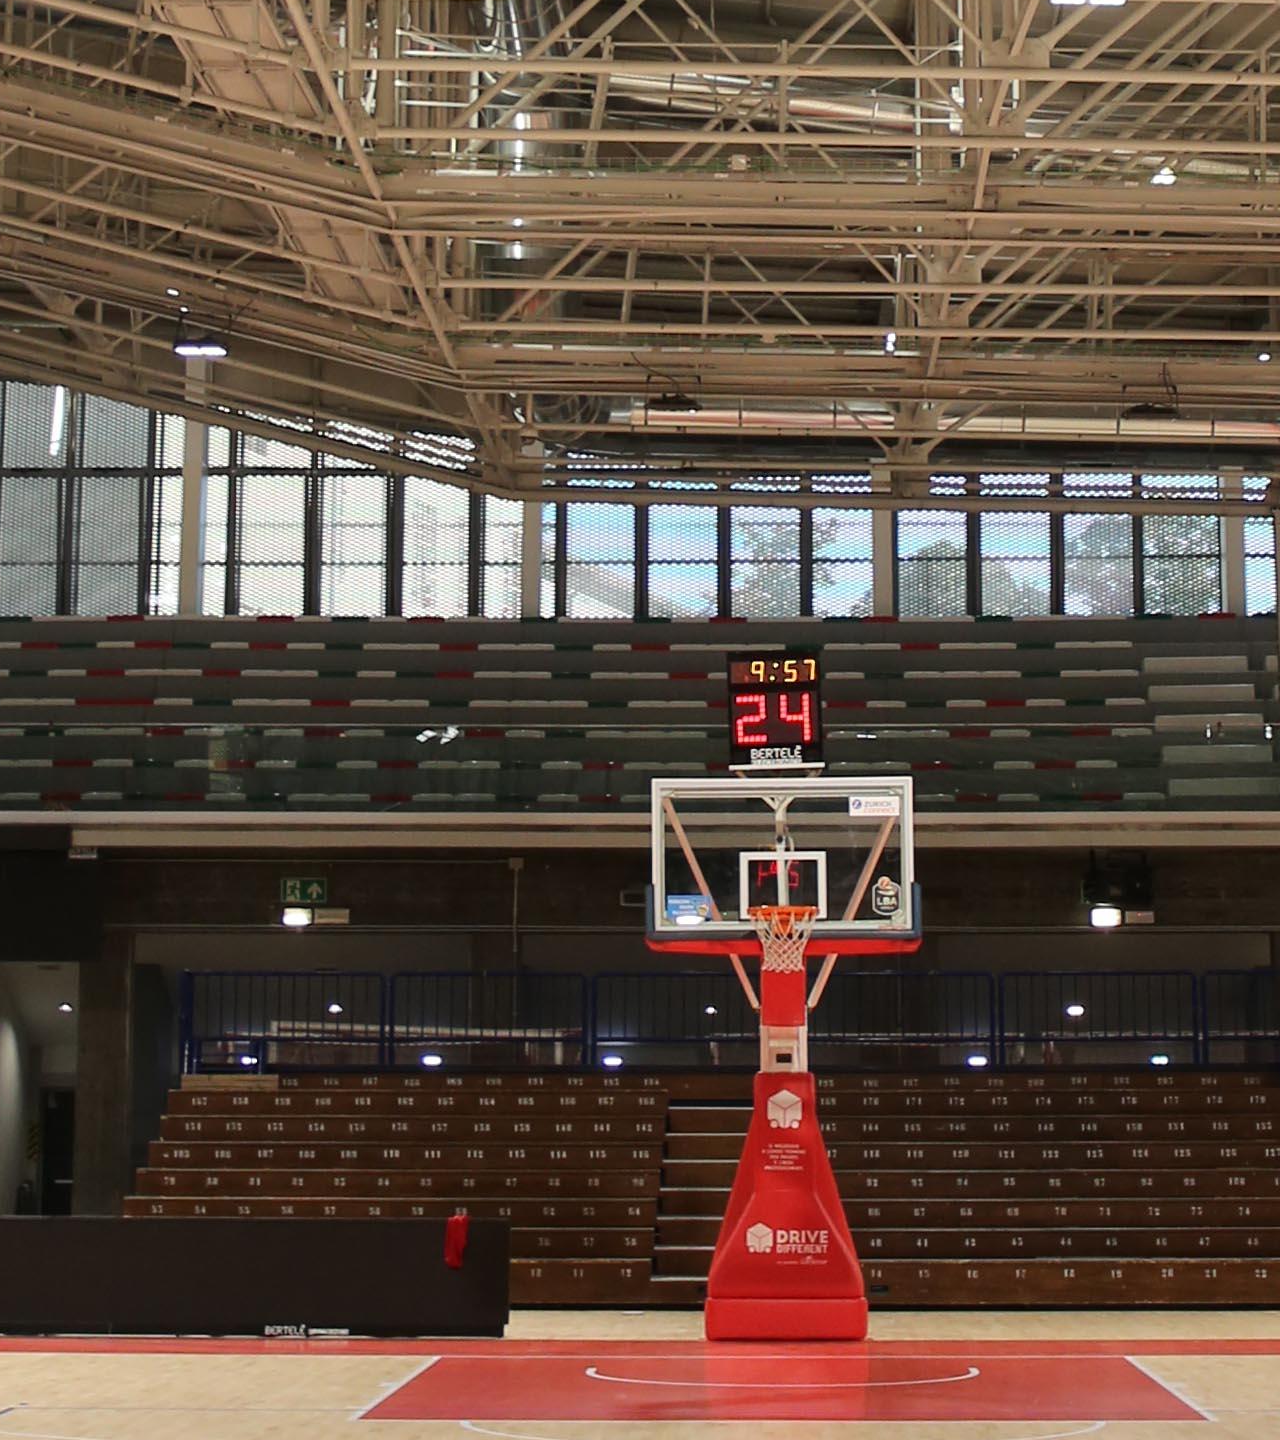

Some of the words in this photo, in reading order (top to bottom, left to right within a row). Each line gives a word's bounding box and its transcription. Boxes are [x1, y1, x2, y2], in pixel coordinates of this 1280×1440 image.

[750, 659, 816, 683] 9:57
[736, 692, 812, 744] 24
[877, 896, 897, 906] LBA
[776, 1230, 829, 1243] DRIVE
[776, 1244, 827, 1254] DIFFERENT
